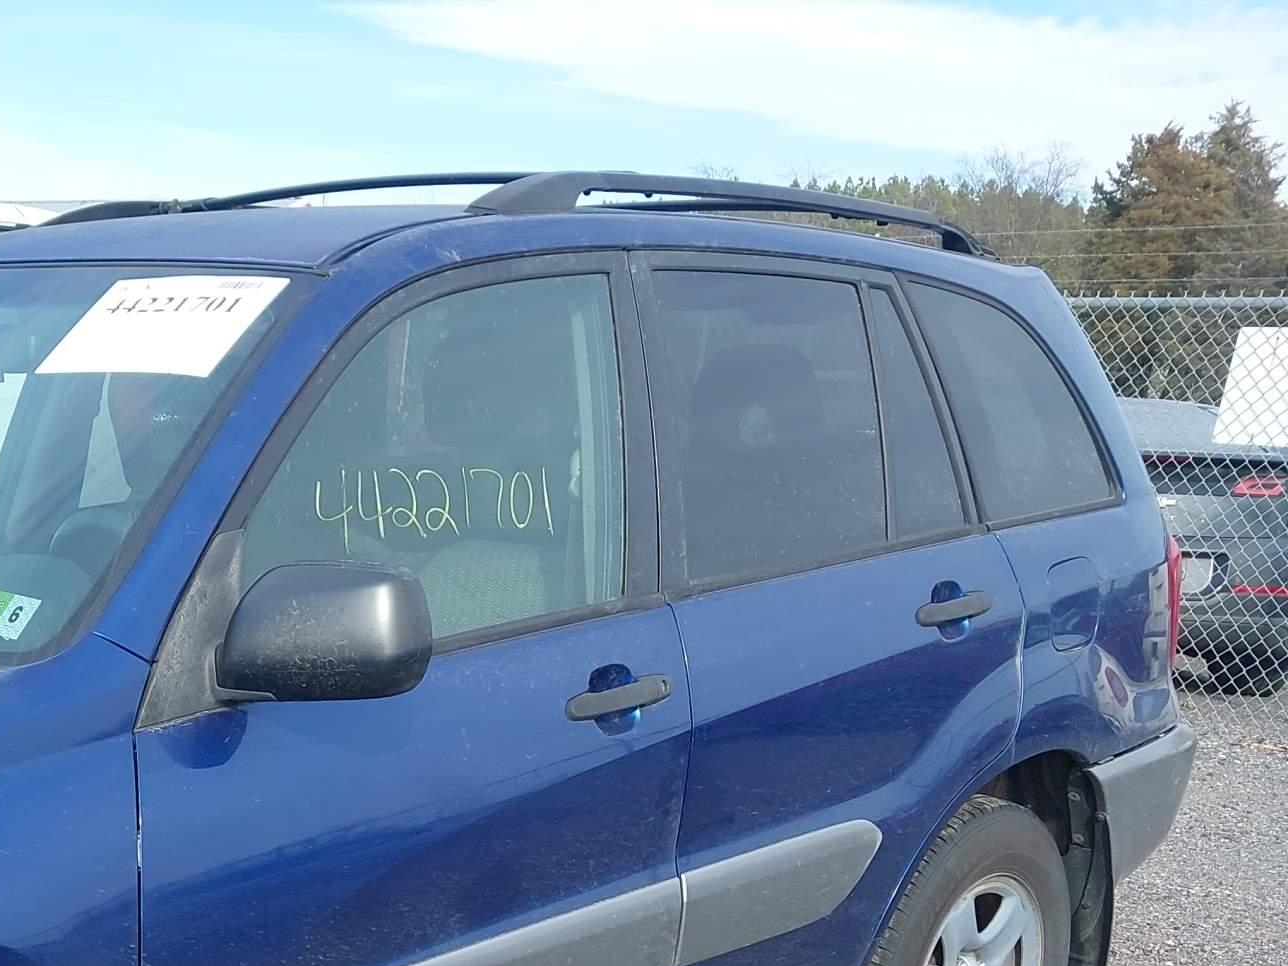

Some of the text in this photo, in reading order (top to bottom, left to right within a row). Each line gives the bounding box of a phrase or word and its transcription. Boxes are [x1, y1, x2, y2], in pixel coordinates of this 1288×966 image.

[107, 297, 243, 314] 44221701
[315, 465, 554, 555] 44221701
[9, 606, 23, 623] 6
